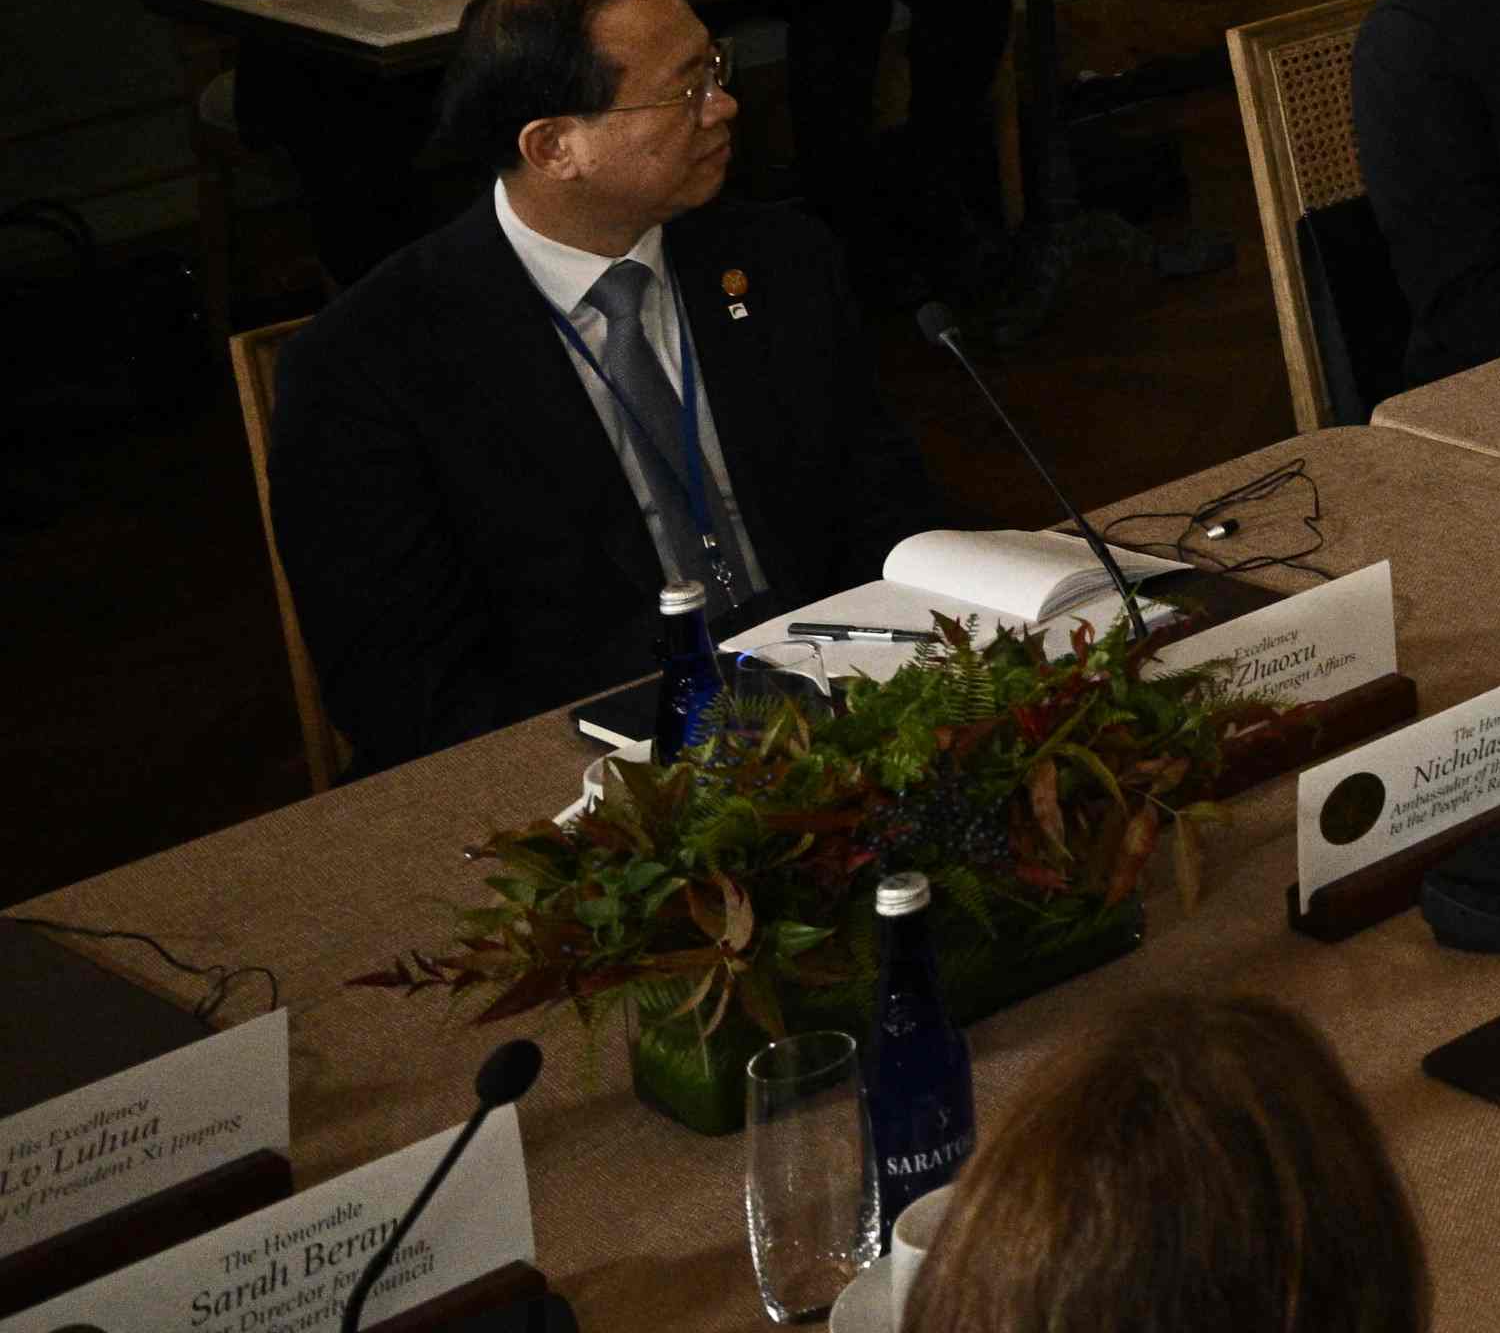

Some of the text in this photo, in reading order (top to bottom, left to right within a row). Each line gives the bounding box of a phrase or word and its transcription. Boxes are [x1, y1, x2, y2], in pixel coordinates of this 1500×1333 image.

[1233, 628, 1299, 662] Excellency
[1234, 644, 1317, 688] Zhaoxu
[1263, 671, 1310, 697] Foreign
[1313, 651, 1357, 679] Affairs
[1454, 723, 1475, 743] The
[1389, 773, 1472, 820] Ambassador
[1474, 762, 1490, 784] of
[1389, 822, 1403, 836] to
[1406, 813, 1426, 830] the
[1430, 784, 1485, 818] People's
[8, 1099, 150, 1164] His Excellency
[53, 1118, 161, 1175] Luhua
[14, 1194, 34, 1221] of
[37, 1156, 135, 1206] President
[222, 1201, 363, 1274] The Honorable
[190, 1217, 403, 1328] Sarah Beran
[239, 1281, 326, 1333] Director
[331, 1268, 362, 1299] for
[372, 1252, 434, 1297] ouncil
